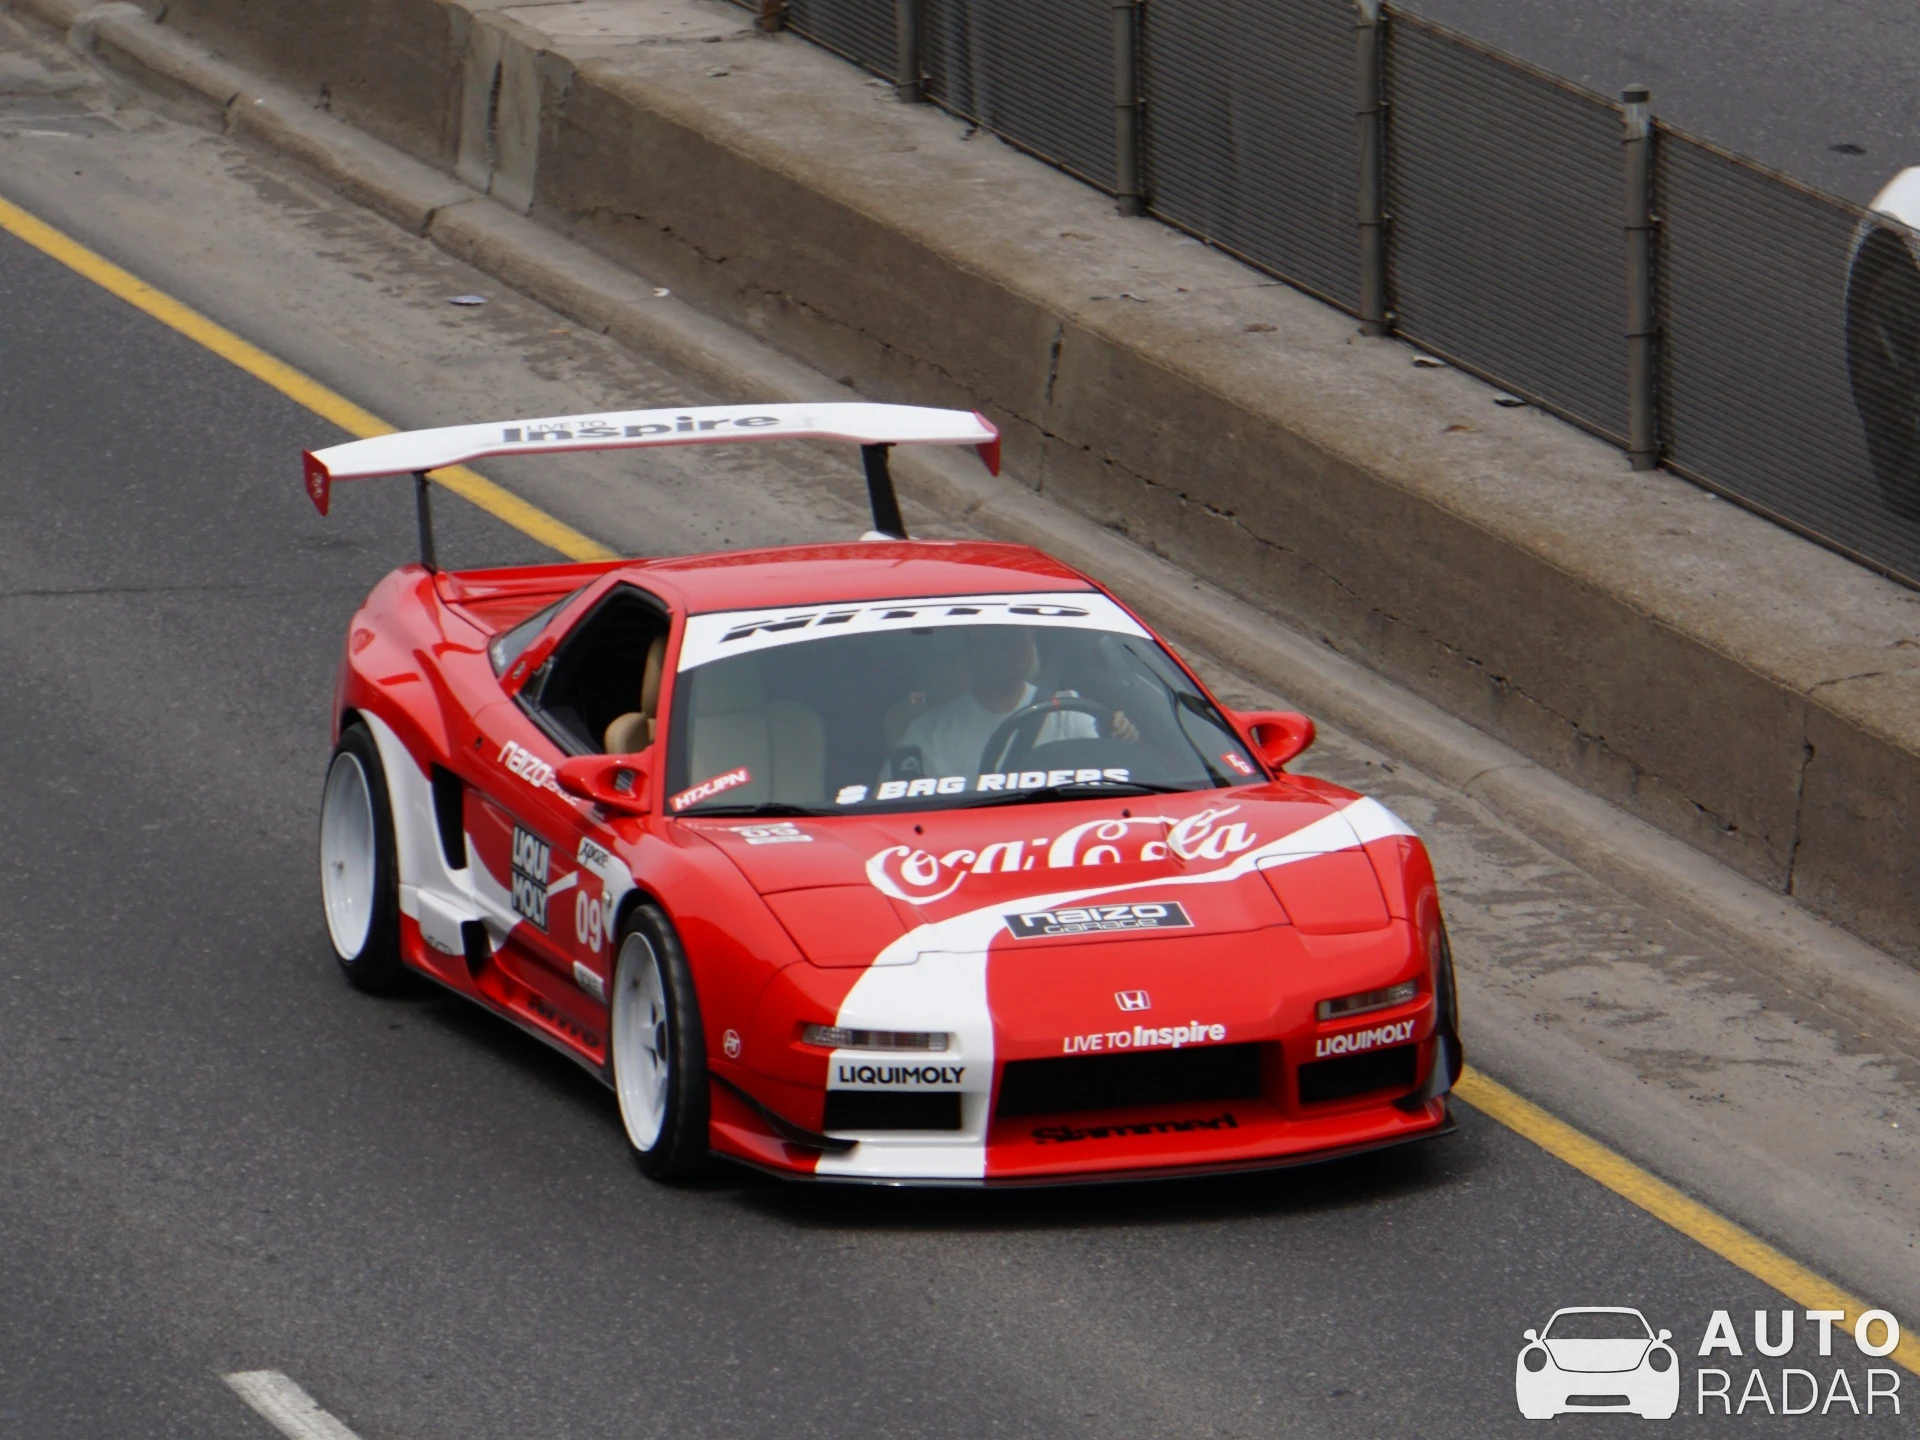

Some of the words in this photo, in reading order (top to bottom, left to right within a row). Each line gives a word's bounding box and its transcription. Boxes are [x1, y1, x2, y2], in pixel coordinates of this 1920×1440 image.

[503, 416, 780, 443] Inspire
[526, 422, 570, 432] LIVE
[577, 419, 607, 428] TO
[877, 776, 966, 800] BAG
[976, 768, 1129, 792] RIDERS
[513, 826, 549, 884] LIQUI
[865, 804, 1256, 905] Coca-Cola
[512, 869, 547, 927] MOLY
[576, 890, 601, 953] 09
[1020, 904, 1167, 927] naizo
[1063, 1033, 1103, 1053] LIVE
[1105, 1031, 1131, 1048] TO
[1133, 1020, 1226, 1048] Inspire
[1315, 1019, 1415, 1058] LIQUIMOLY
[839, 1065, 965, 1084] LIQUIMOLY
